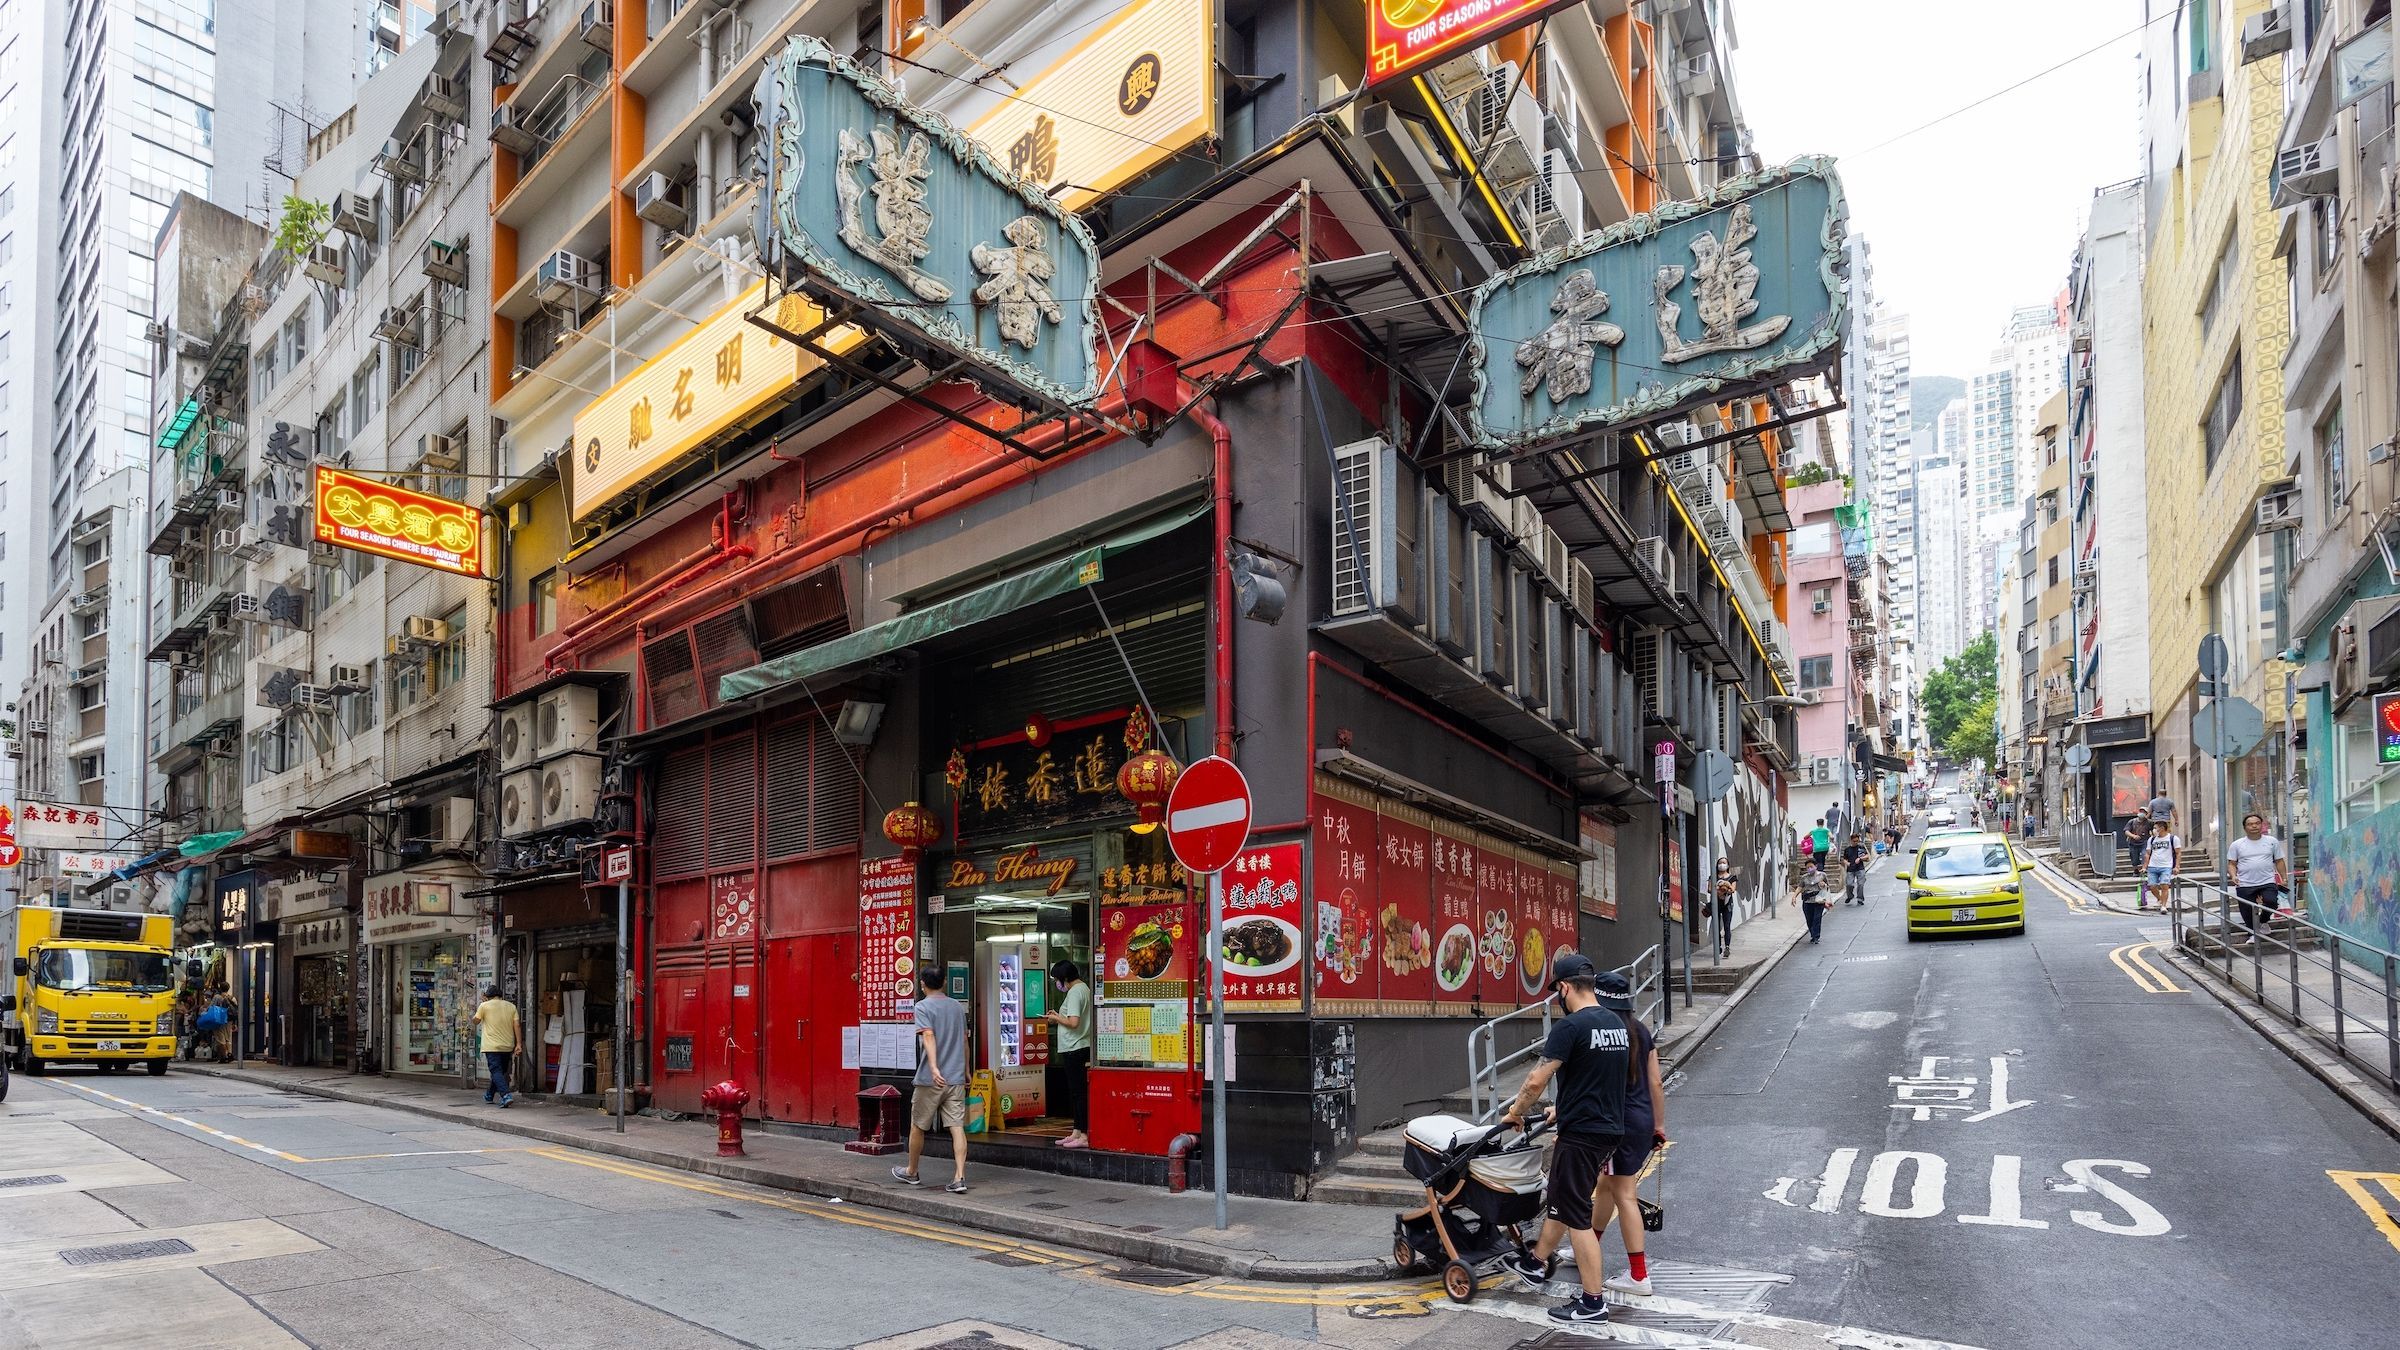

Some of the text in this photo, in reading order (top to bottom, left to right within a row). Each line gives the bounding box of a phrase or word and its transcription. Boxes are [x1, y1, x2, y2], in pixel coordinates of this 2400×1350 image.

[1406, 20, 1437, 48] FOUR
[1439, 0, 1492, 32] SEASONS
[1123, 61, 1155, 108] 興
[331, 493, 468, 547] 文興酒家
[340, 527, 461, 563] FOUR SEASONS CHINESE RESTAURANT
[2028, 736, 2048, 744] Aesop
[23, 805, 100, 826] 森記書局
[1323, 808, 1351, 844] 中秋
[1236, 853, 1273, 872] 蓮香樓
[1339, 850, 1366, 883] 月餅
[1386, 833, 1424, 872] 嫁女餅
[1435, 837, 1472, 878] 蓮香樓
[946, 860, 987, 888] Lin
[994, 851, 1078, 896] Heung
[1104, 861, 1186, 888] 蓮香老餅家
[1101, 893, 1116, 904] Lin
[1149, 889, 1185, 900] Bakery
[1255, 982, 1298, 995] 提早預定
[1590, 1028, 1629, 1049] ACTIVE
[1888, 1056, 2038, 1122] 停
[1762, 1148, 2172, 1237] STOP
